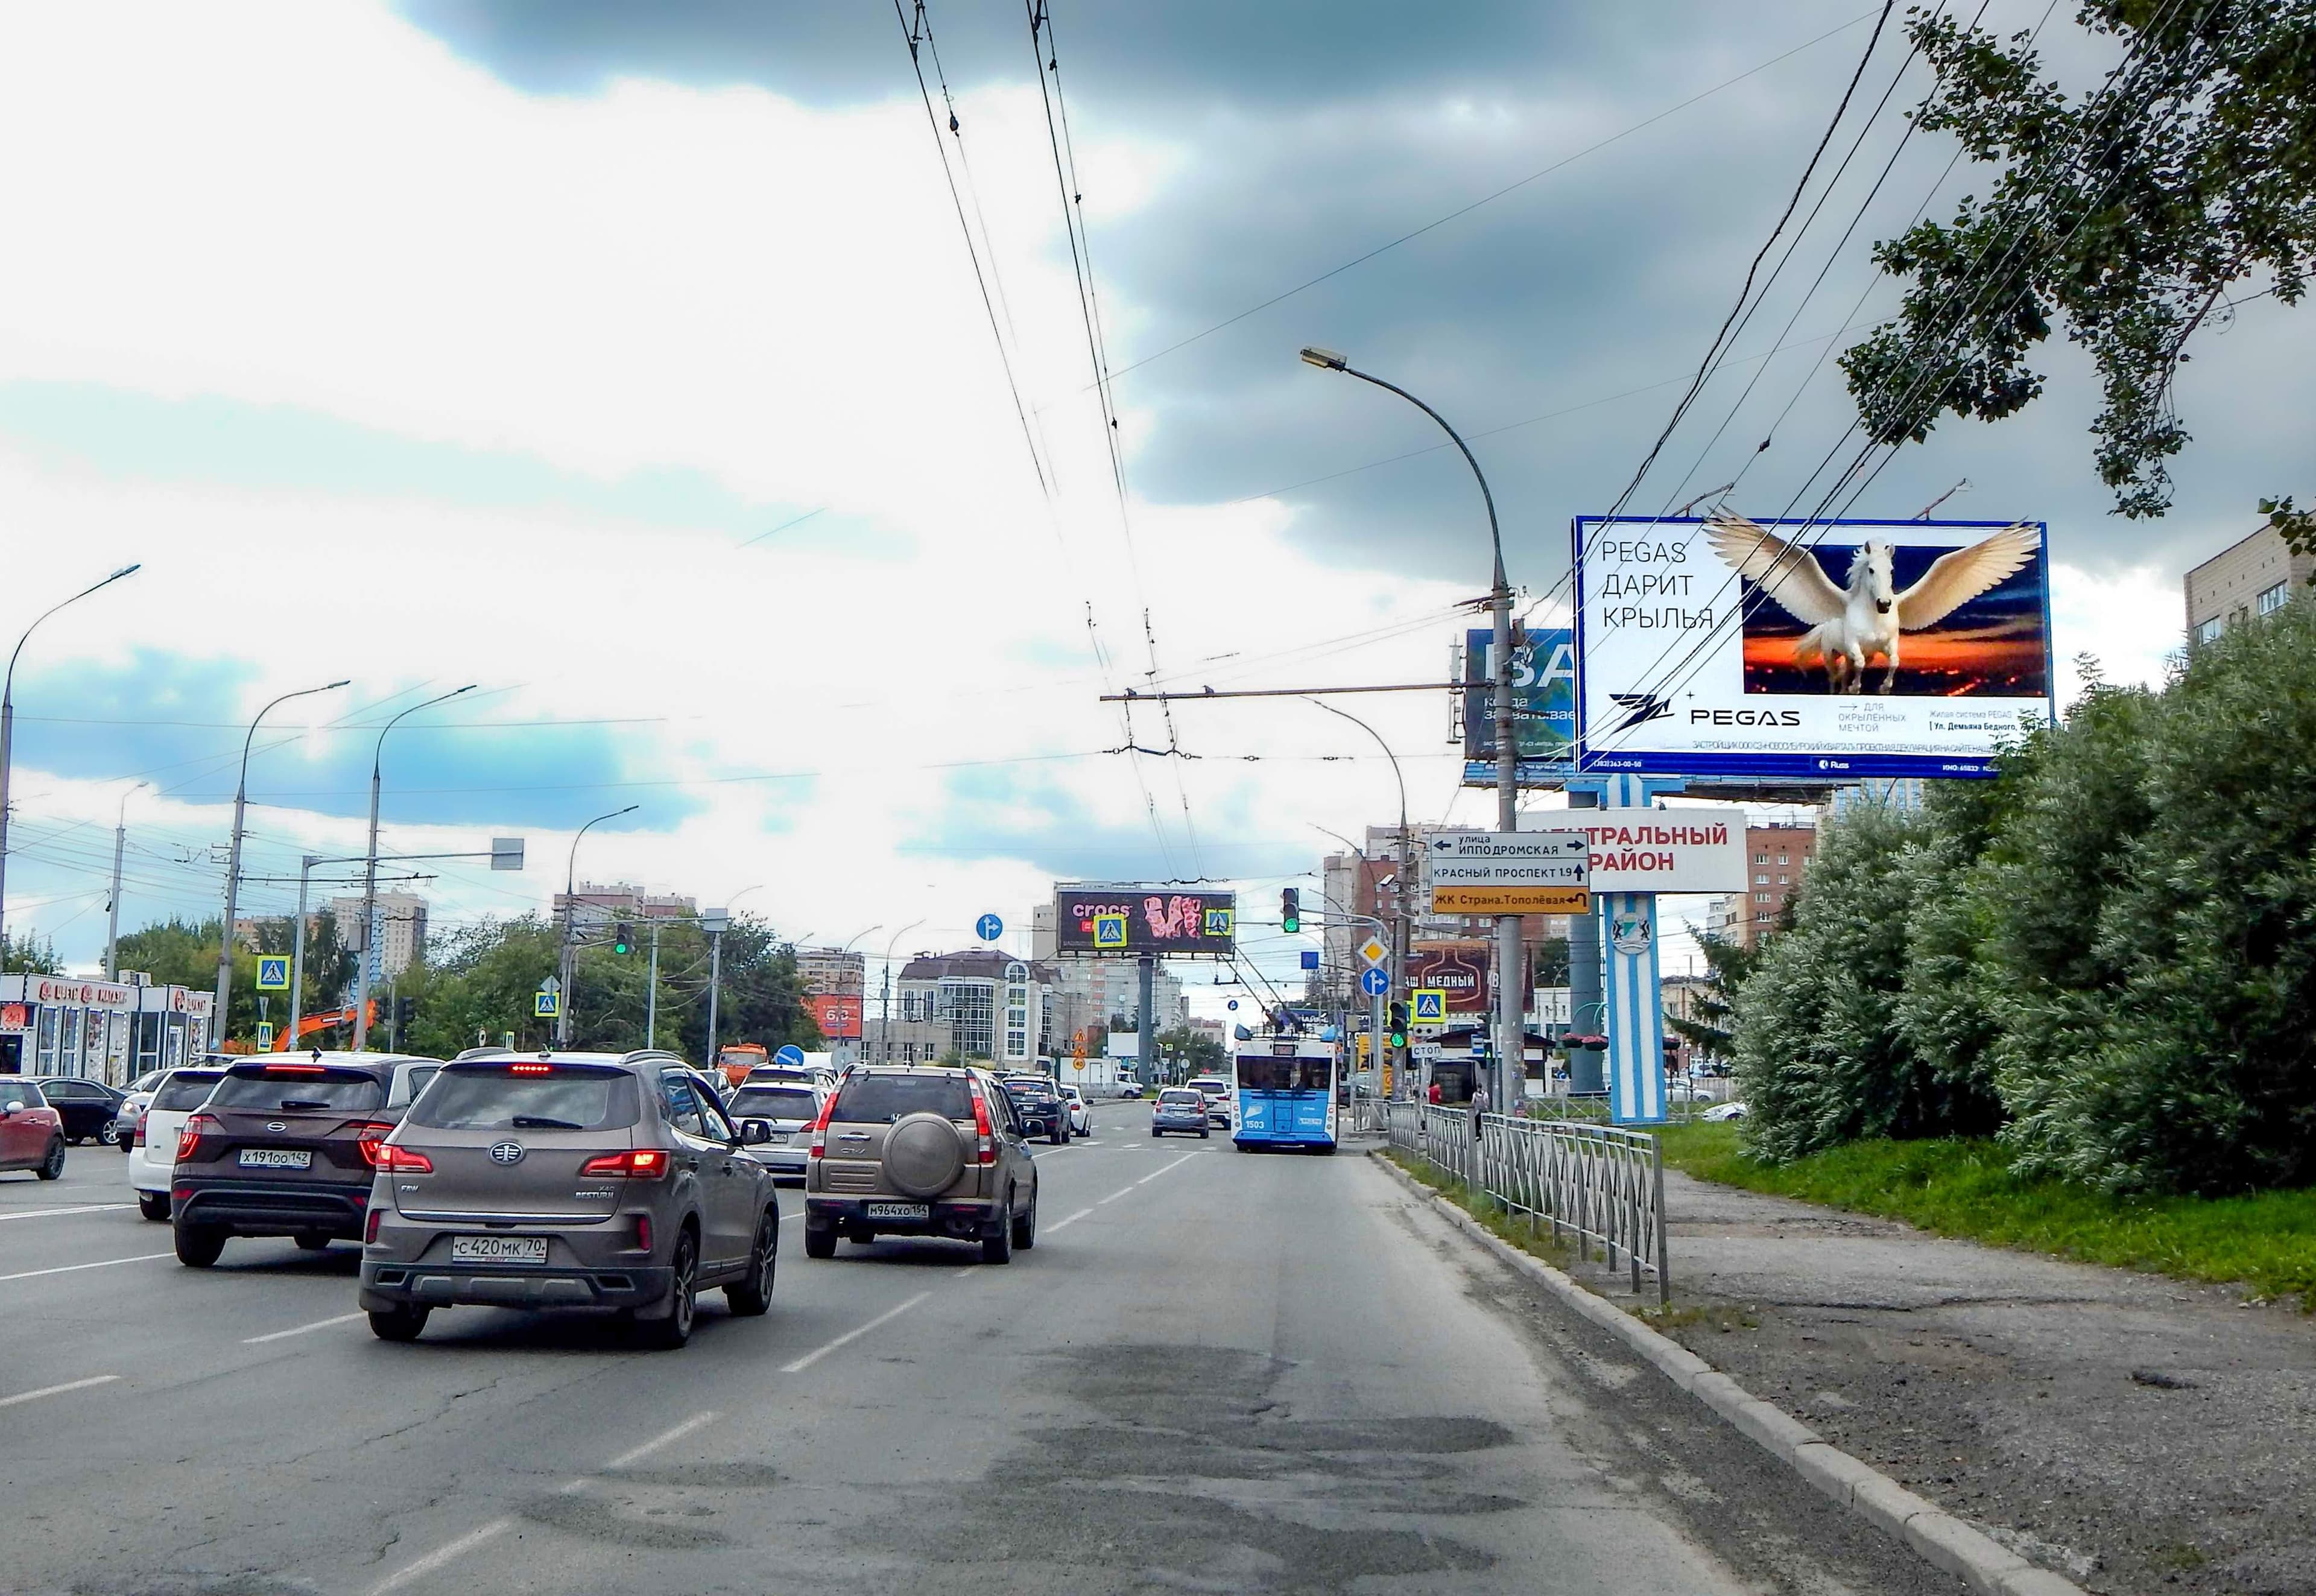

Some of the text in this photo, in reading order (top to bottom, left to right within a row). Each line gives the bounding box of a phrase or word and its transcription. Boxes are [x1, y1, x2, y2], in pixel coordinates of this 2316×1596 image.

[1603, 541, 1686, 563] PEGAS
[1602, 574, 1694, 599] ДАРИТ
[1604, 607, 1713, 629] КРЫЛЬЯ
[1864, 703, 1885, 712] ДЛЯ
[1691, 709, 1800, 726] PEGAS
[1839, 723, 1879, 732] МЕЧТОЙ
[1947, 722, 1982, 731] Демьяна
[1984, 722, 2018, 732] Бедного,
[1830, 761, 1850, 769] Russ
[1458, 835, 1491, 845] улица
[1532, 822, 1728, 846] ТРАЛЬНЫЙ
[1458, 845, 1558, 855] ИППОДРОМСКАЯ
[1589, 848, 1674, 872] РАЙОН
[1434, 867, 1490, 878] КРАСНЫЙ
[1495, 869, 1556, 878] ПРОСПЕКТ
[1435, 894, 1565, 906] ЖК Страна.Тополёвая
[1072, 904, 1131, 918] crocs
[1426, 973, 1475, 987] МЕДНЫЙ
[1486, 969, 1501, 988] КВ
[1413, 1046, 1441, 1055] СТОП
[1245, 1120, 1265, 1129] 1503
[526, 1239, 542, 1252] 70
